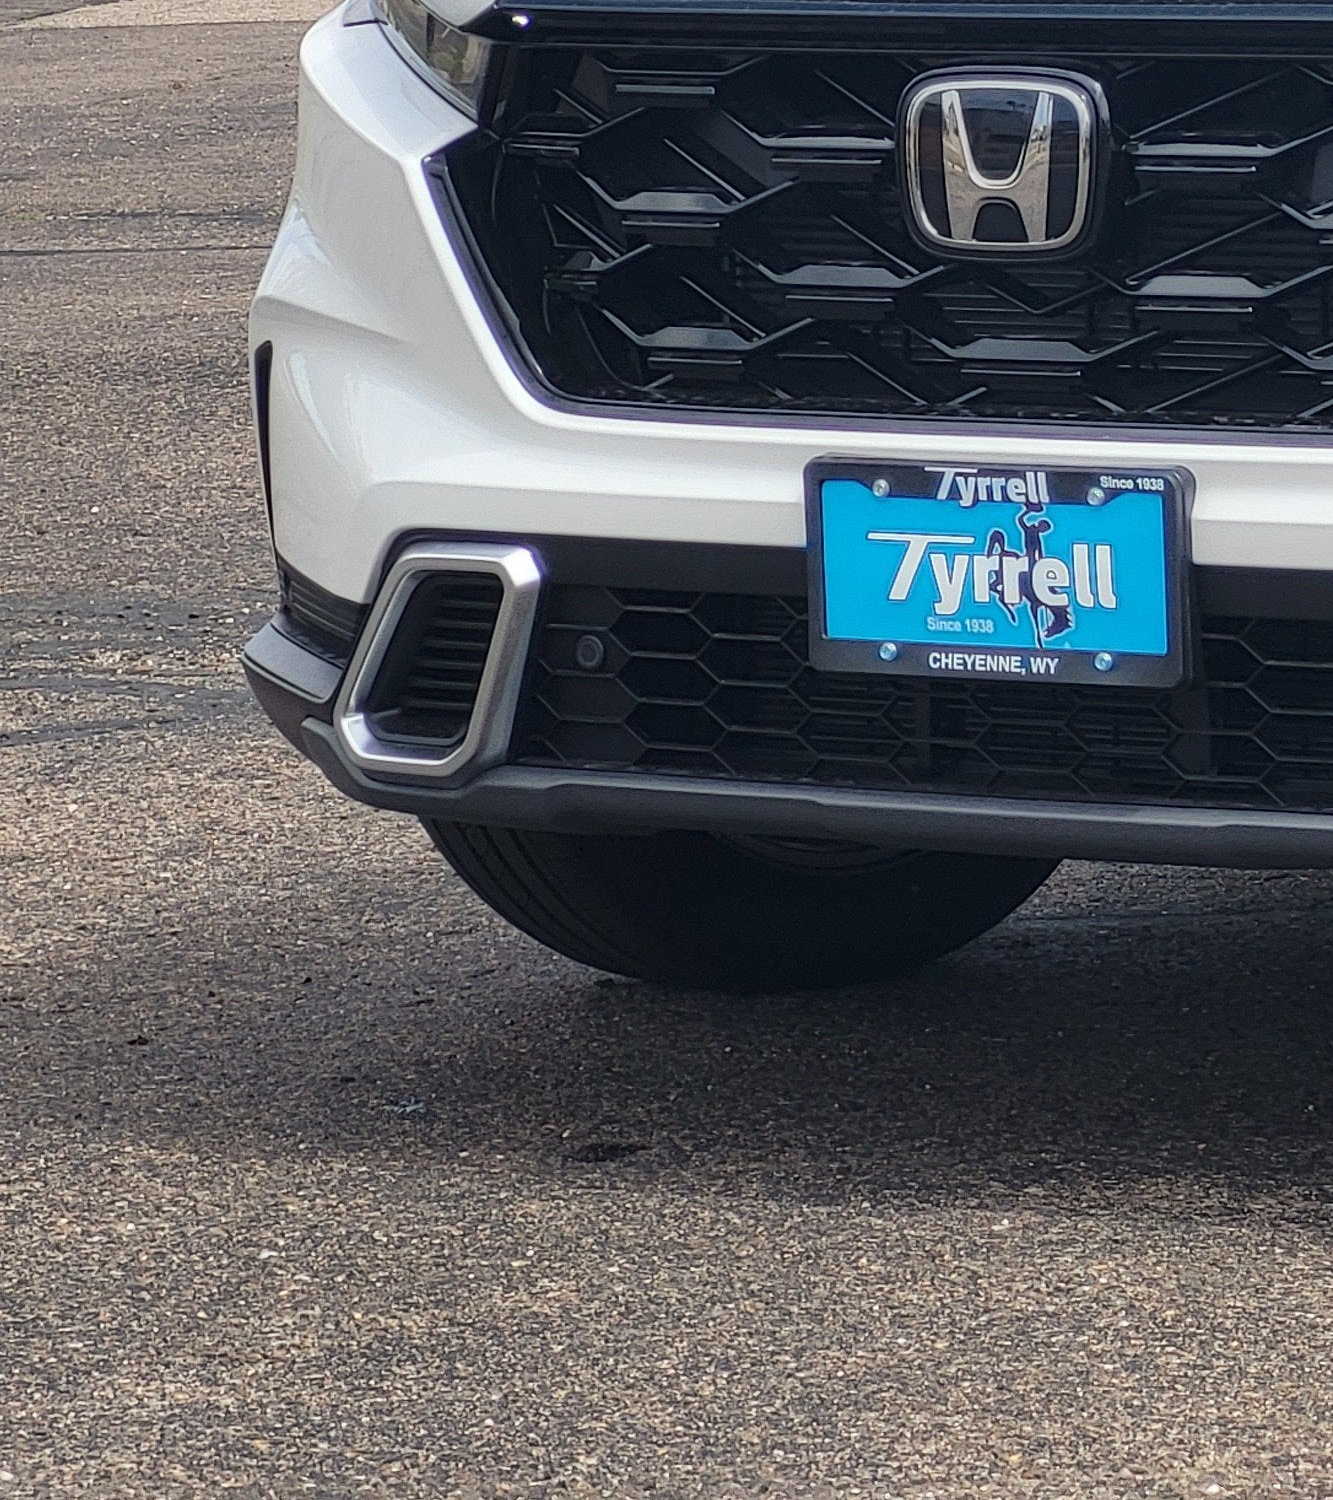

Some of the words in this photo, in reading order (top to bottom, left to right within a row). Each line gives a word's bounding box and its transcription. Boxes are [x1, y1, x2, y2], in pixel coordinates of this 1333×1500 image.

[923, 466, 1050, 507] Tyrrell
[1100, 475, 1134, 490] Since
[1136, 477, 1165, 491] 1938
[866, 532, 1118, 616] Tyrrell
[927, 616, 962, 632] Since
[965, 618, 994, 634] 1938
[929, 652, 1026, 676] CHEYENNE,
[1030, 656, 1059, 675] WY
